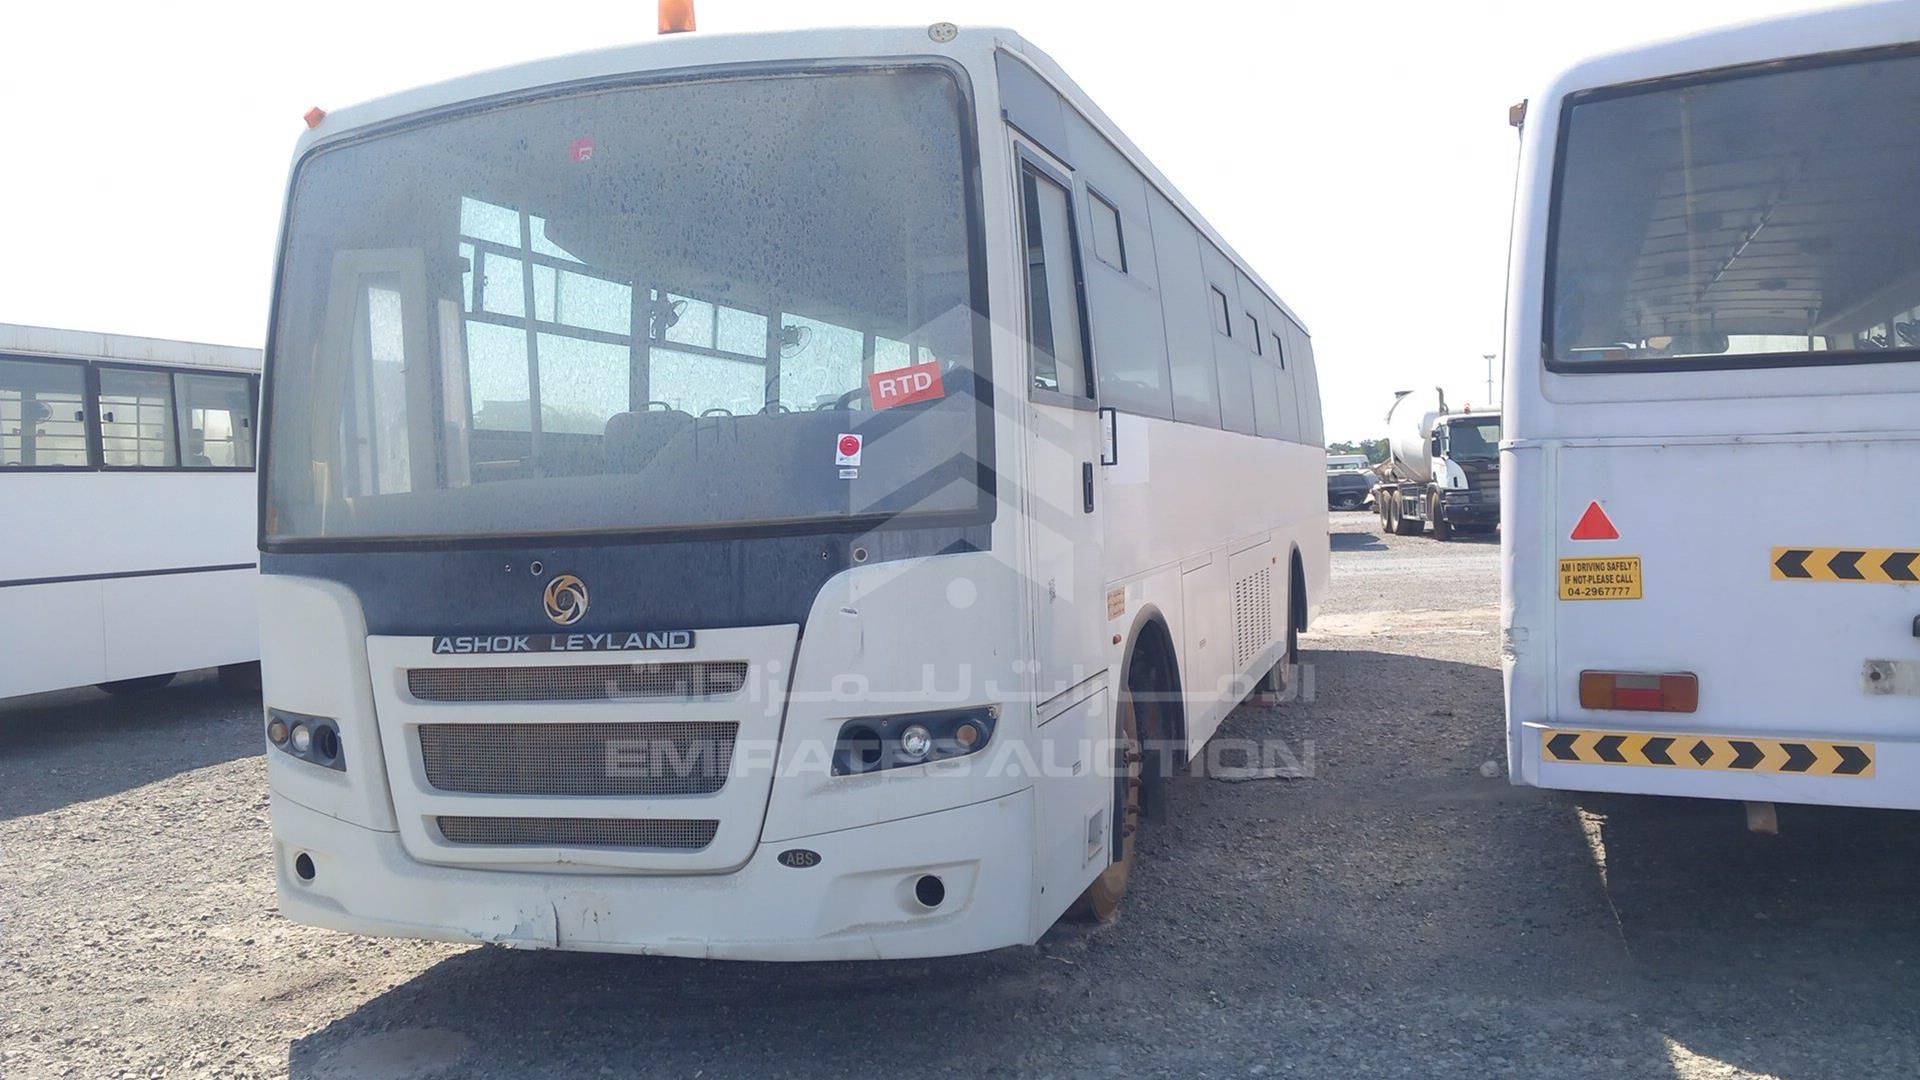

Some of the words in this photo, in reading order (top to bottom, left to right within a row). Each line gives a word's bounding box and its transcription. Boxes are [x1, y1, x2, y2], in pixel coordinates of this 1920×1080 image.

[878, 372, 933, 398] RTD
[1561, 563, 1571, 572] AM
[1577, 562, 1605, 572] DRIVING
[1607, 562, 1633, 571] SAFELY
[1565, 575, 1571, 584] IF
[1616, 574, 1633, 583] CALL
[1568, 587, 1631, 596] 04-2967777
[435, 636, 531, 653] ASHOK
[550, 631, 690, 650] LEYLAND
[786, 852, 814, 866] ABS
